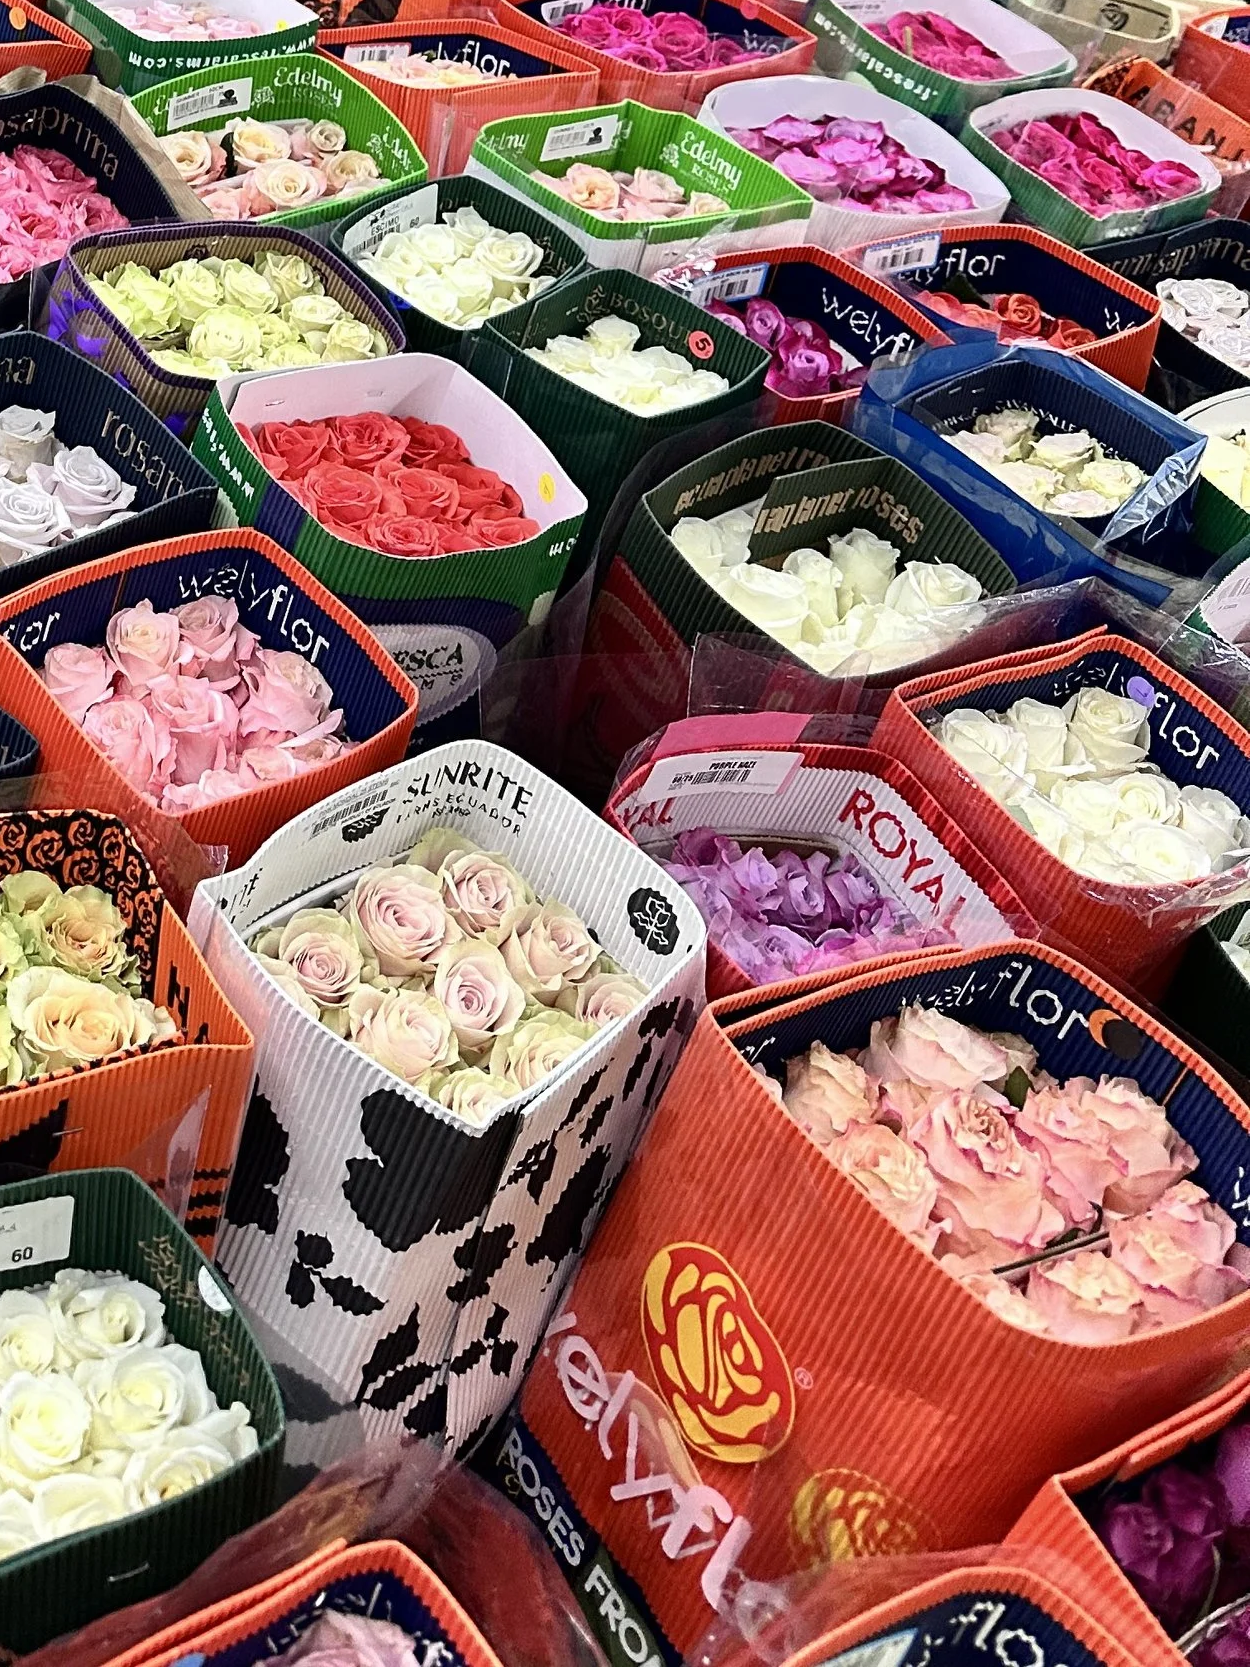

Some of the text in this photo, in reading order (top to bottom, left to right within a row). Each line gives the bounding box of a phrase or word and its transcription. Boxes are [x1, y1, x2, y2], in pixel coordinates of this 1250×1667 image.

[273, 66, 344, 109] Edelmy
[678, 129, 743, 187] Edelmy
[609, 292, 693, 344] BOSQU
[177, 557, 331, 665] welyflor
[402, 760, 534, 819] SUNRITE
[709, 761, 737, 771] PURPLE
[445, 792, 523, 838] ECUADOR
[10, 1246, 34, 1264] 60
[497, 1429, 586, 1569] ROSES
